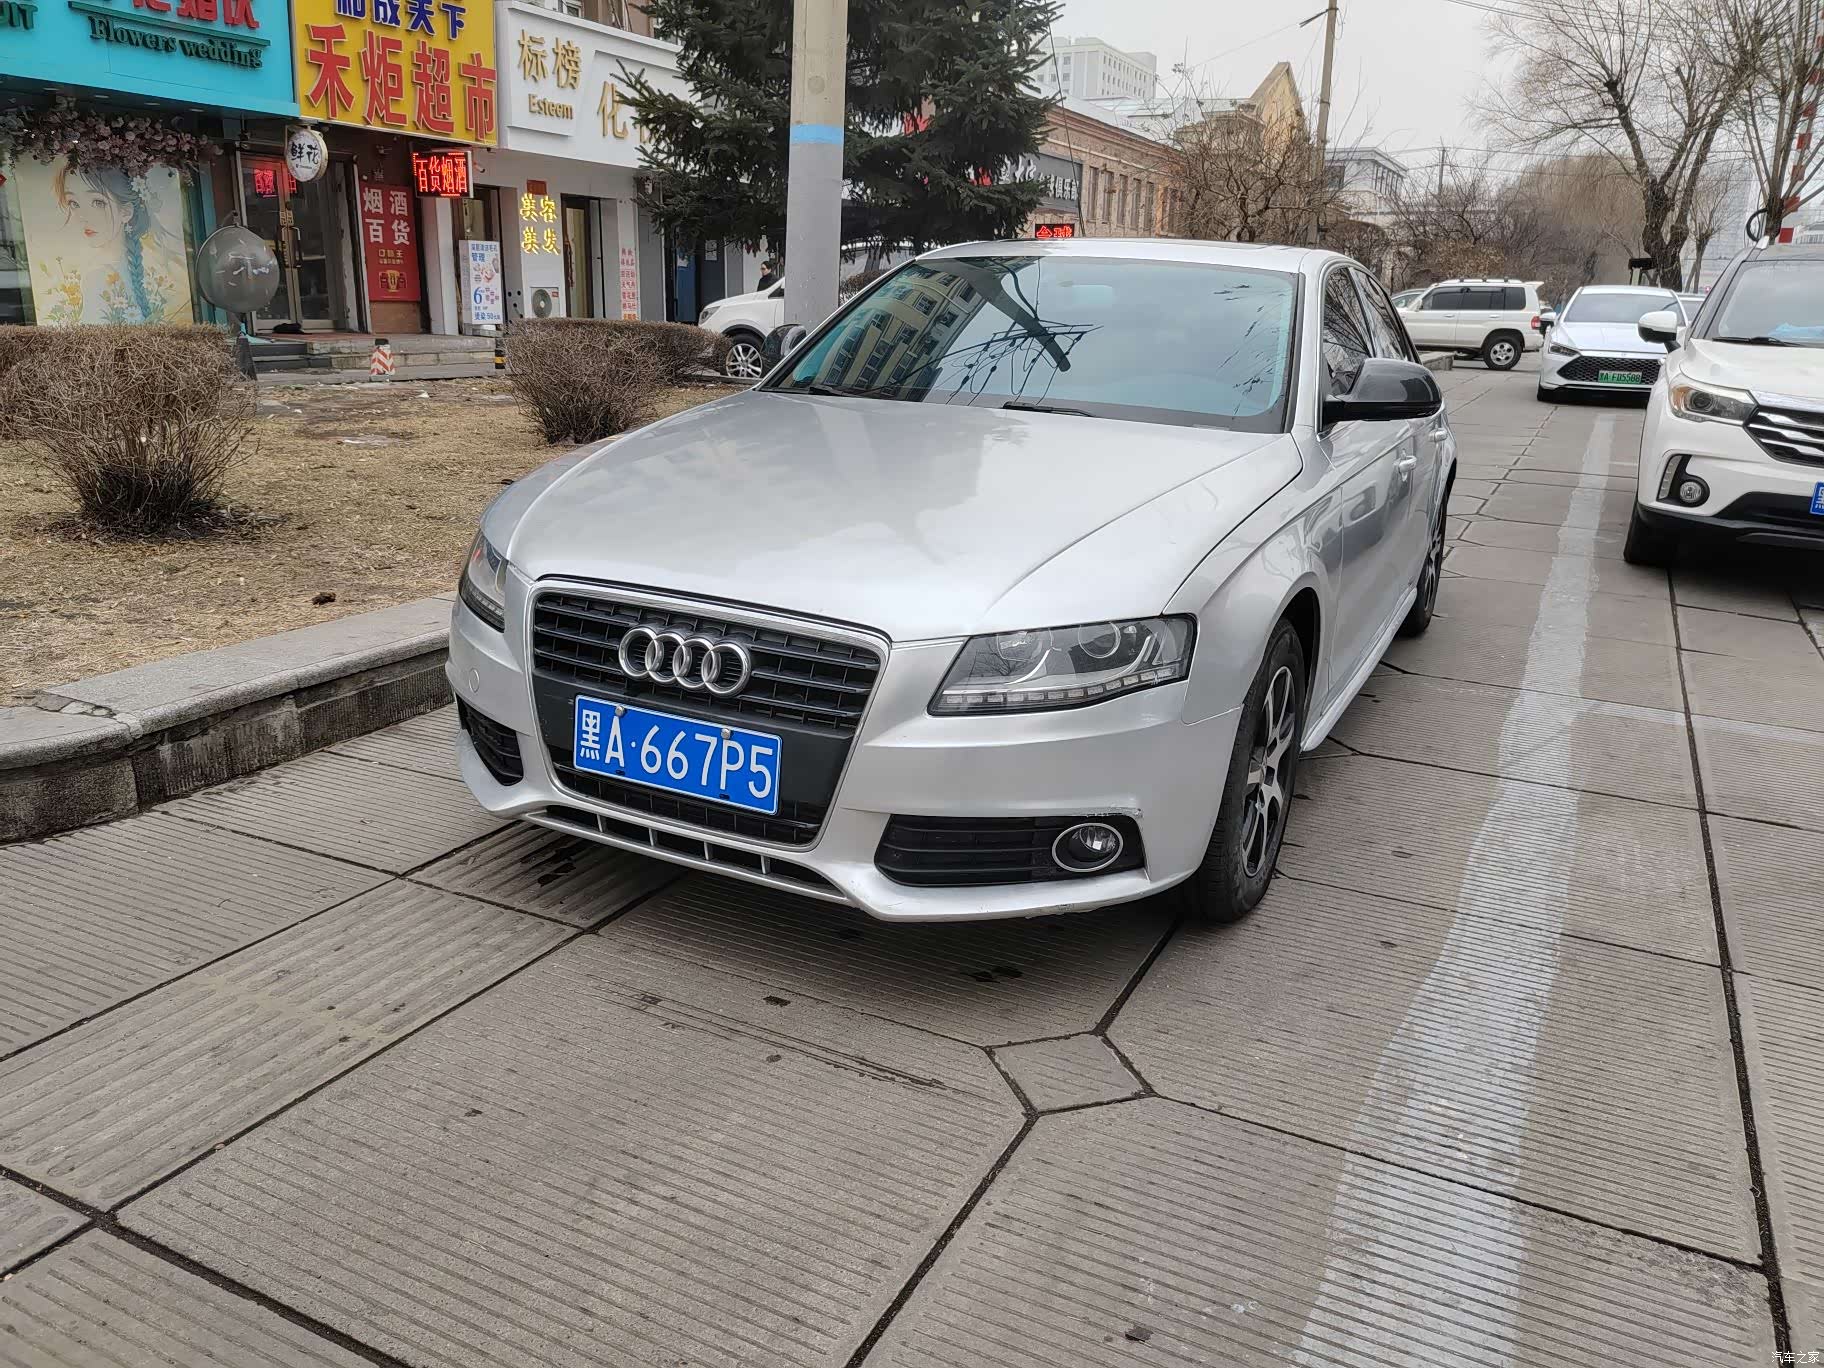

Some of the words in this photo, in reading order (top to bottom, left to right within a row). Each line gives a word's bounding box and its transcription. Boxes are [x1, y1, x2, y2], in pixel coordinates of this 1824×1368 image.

[88, 15, 177, 52] Flowers
[179, 38, 263, 68] wedding
[518, 29, 582, 89] 标榜
[306, 22, 496, 141] 禾炬超市
[528, 93, 573, 120] Esteem
[290, 142, 319, 165] 鲜花
[415, 155, 468, 193] 百货烟酒
[363, 187, 408, 216] 烟酒
[519, 193, 557, 223] 美容
[365, 218, 410, 246] 百货
[580, 708, 773, 799] 黑A·667P5
